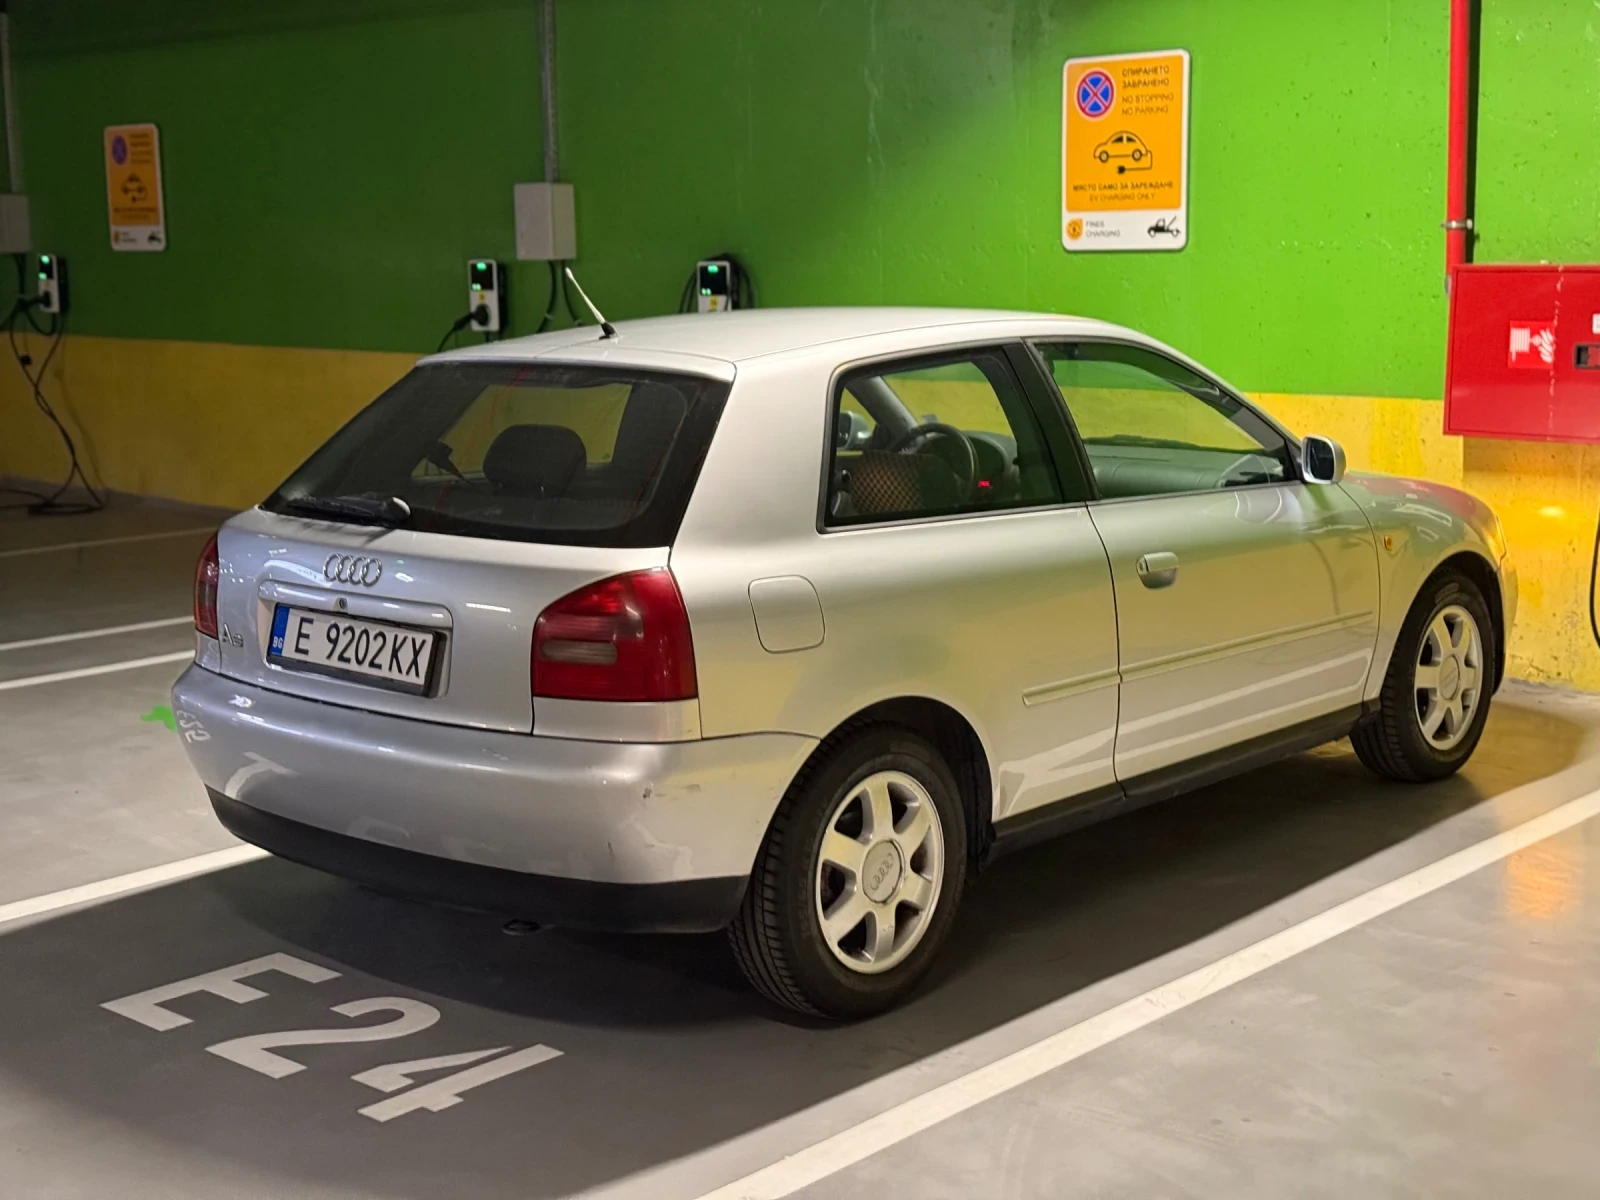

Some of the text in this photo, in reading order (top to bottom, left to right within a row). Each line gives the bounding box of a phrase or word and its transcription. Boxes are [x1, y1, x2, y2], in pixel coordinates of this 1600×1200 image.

[1122, 92, 1174, 104] NO STOPPING
[1122, 105, 1169, 116] NO PARKING
[273, 635, 284, 649] BG
[294, 616, 426, 678] E 9202KX
